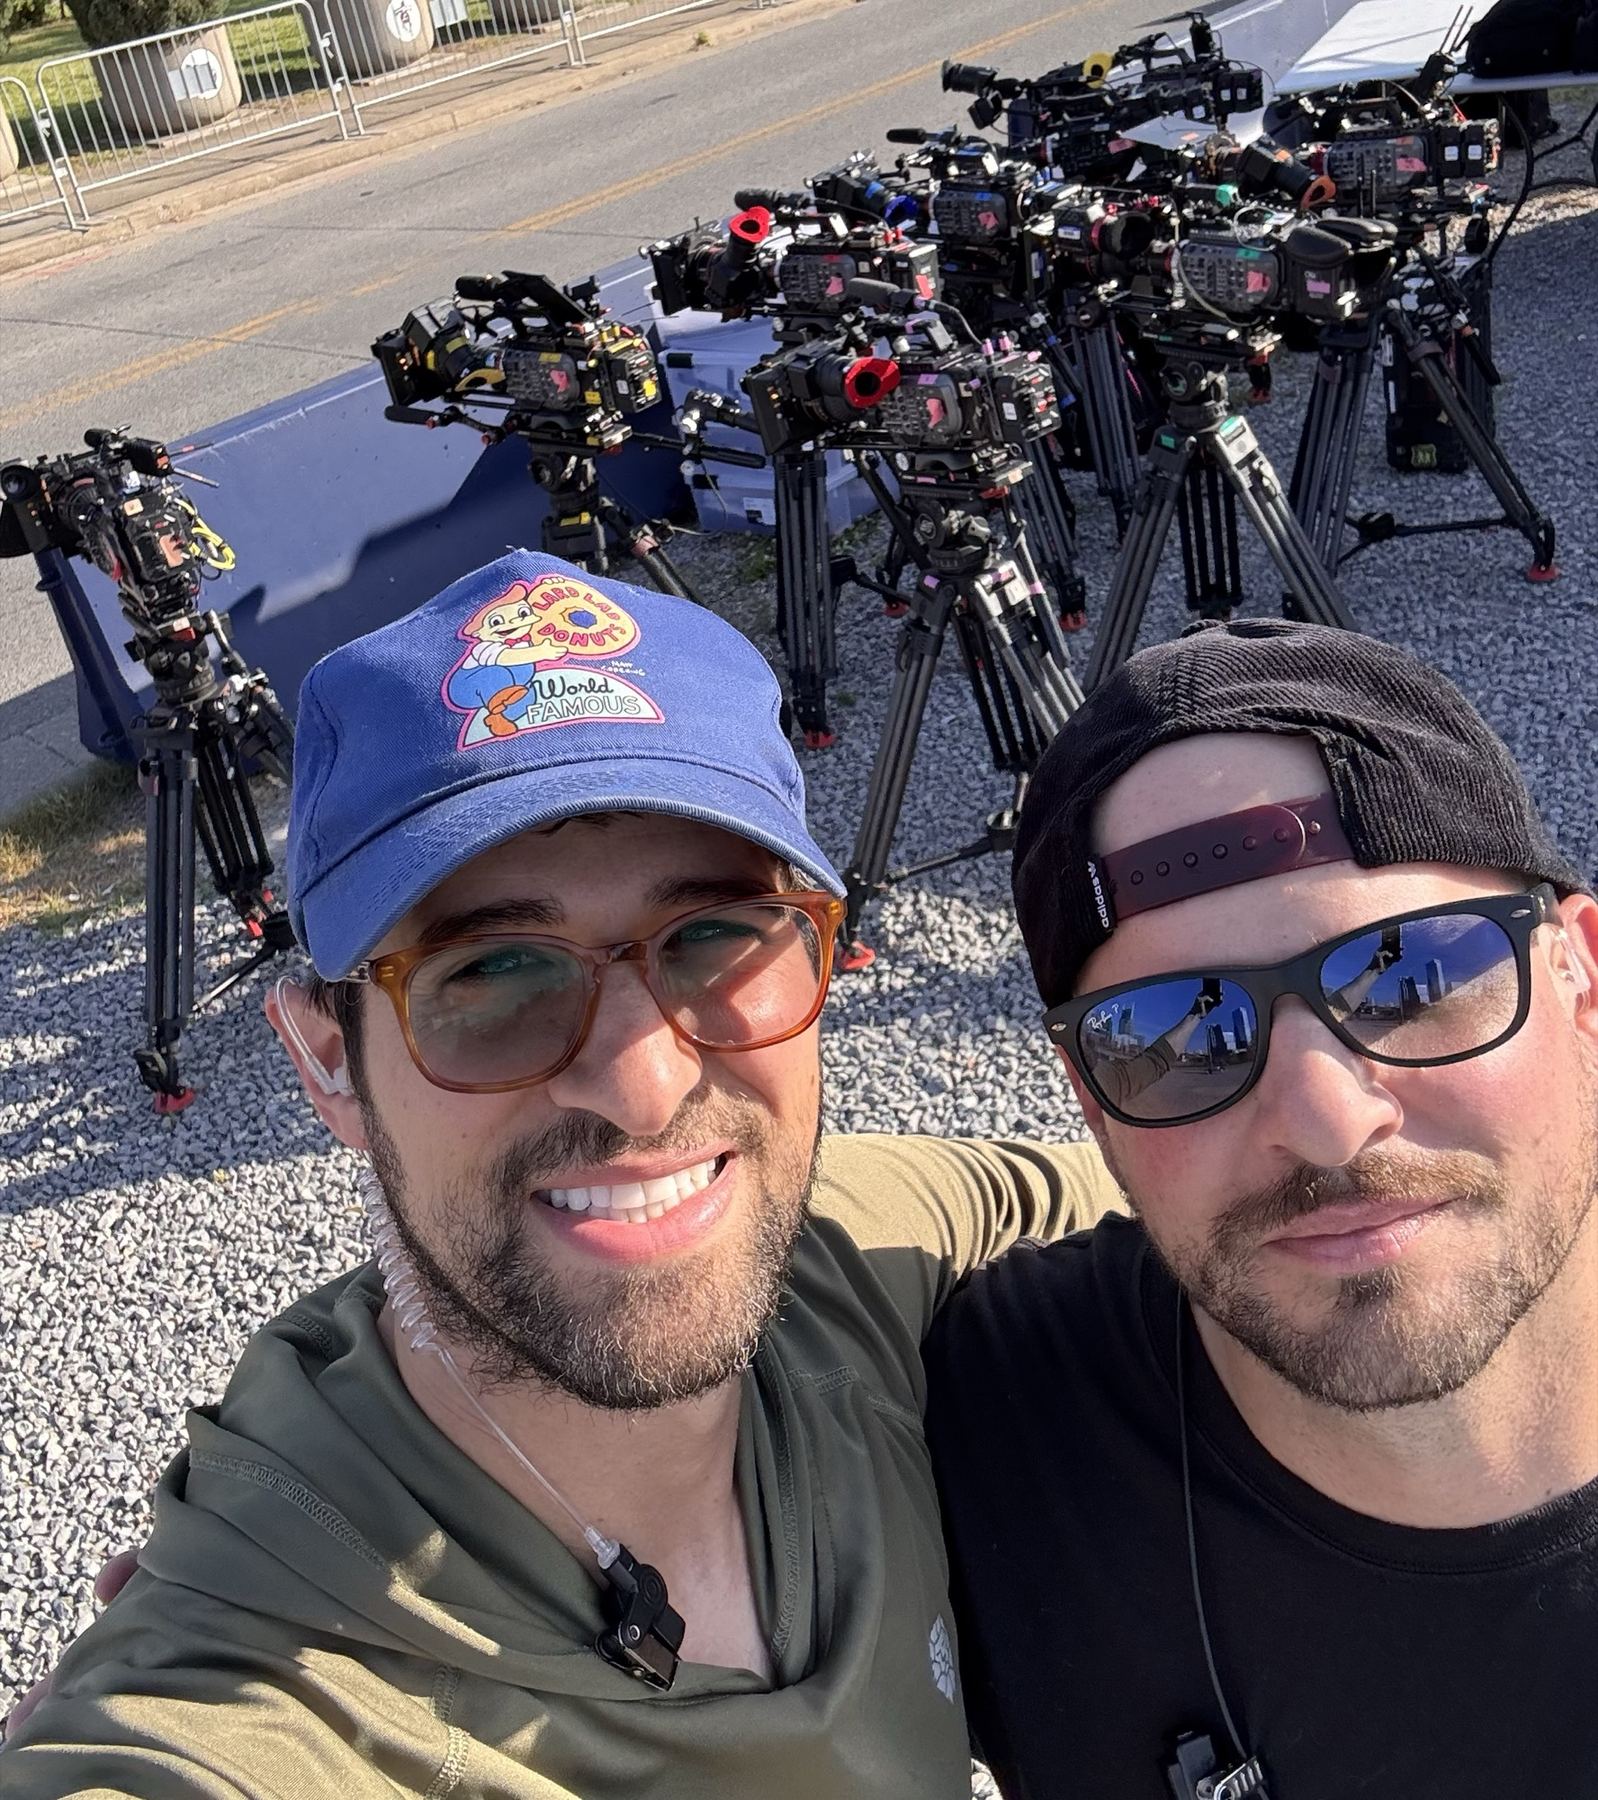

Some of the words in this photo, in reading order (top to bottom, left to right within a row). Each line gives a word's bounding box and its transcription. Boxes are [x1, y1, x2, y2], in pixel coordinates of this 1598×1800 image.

[532, 586, 579, 610] LARD
[583, 593, 621, 620] LAD
[537, 623, 626, 647] DONUTS
[530, 675, 614, 699] World
[526, 695, 641, 724] FAMOUS
[1092, 876, 1110, 928] adidas
